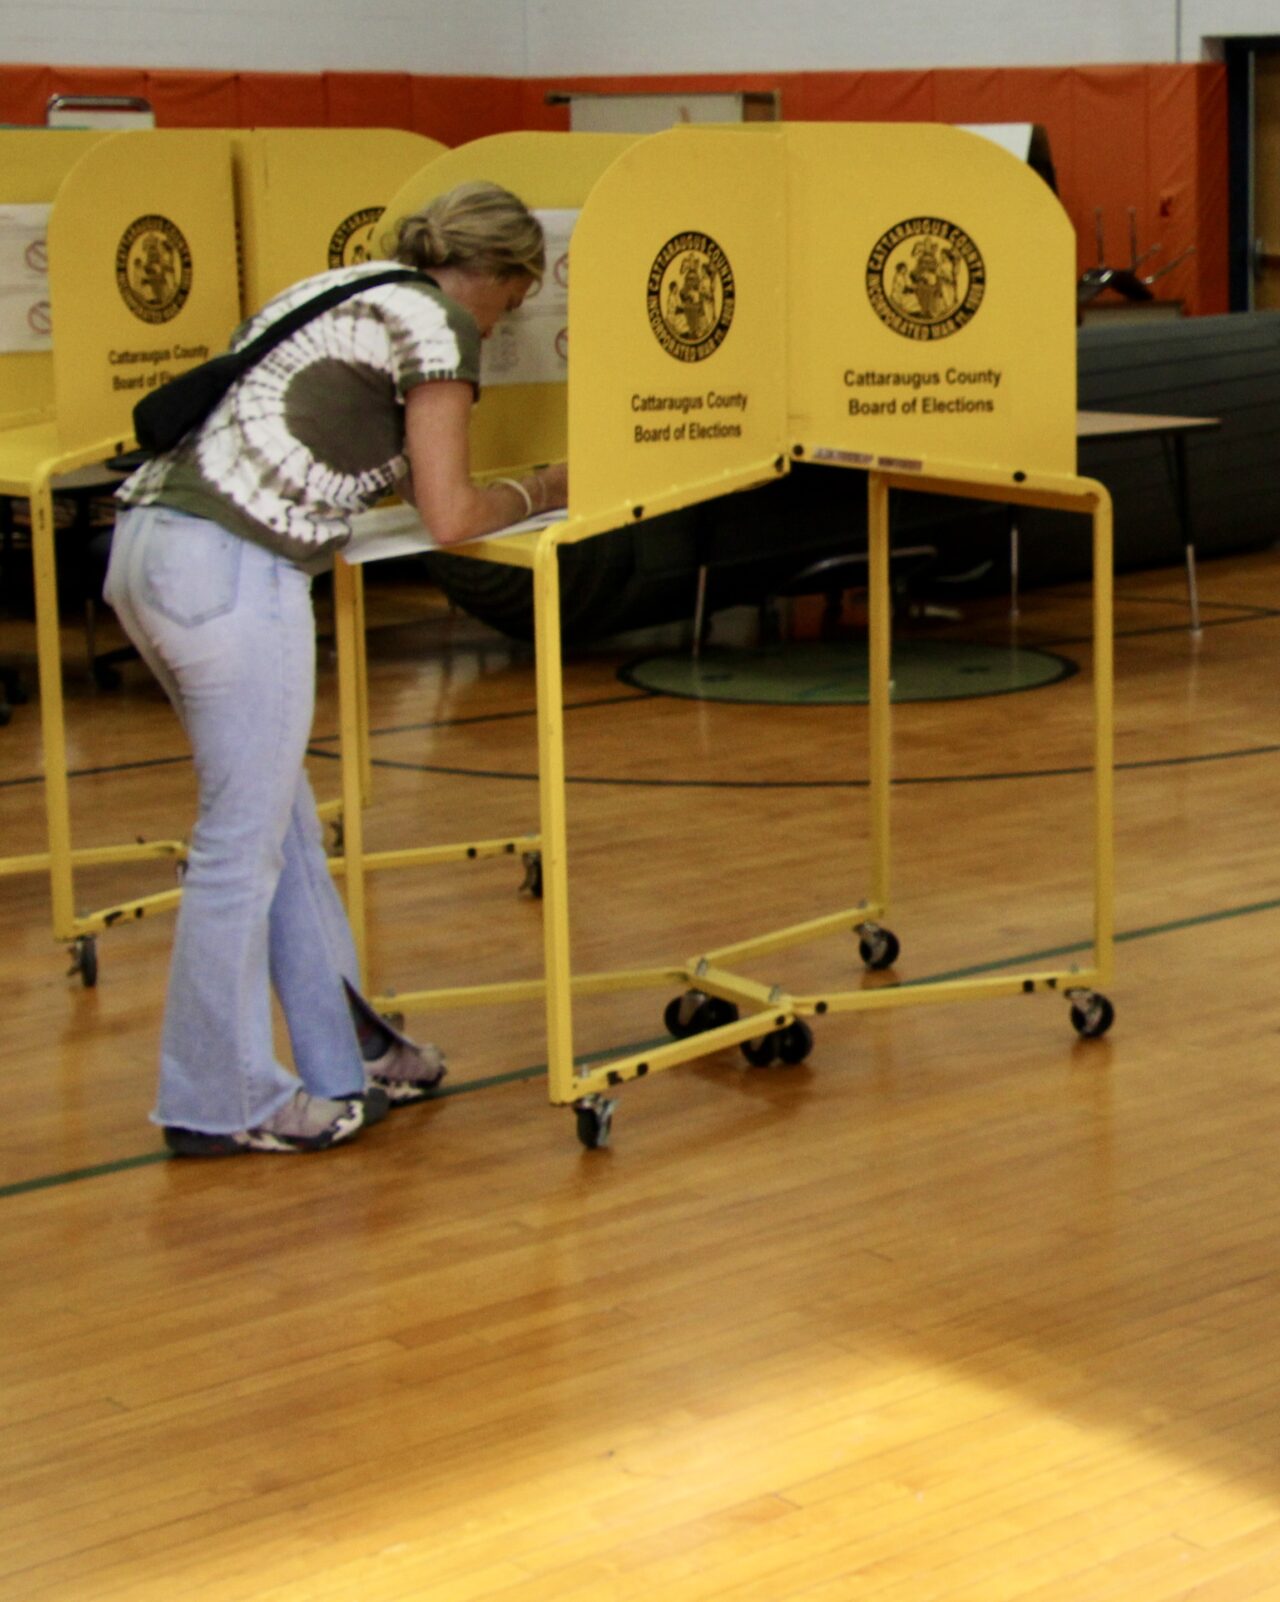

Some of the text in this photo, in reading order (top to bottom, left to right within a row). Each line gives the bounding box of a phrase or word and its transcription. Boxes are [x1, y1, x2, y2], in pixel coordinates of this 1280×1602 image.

[869, 219, 949, 270] CATTARAUGUS
[649, 233, 707, 288] CATTARAUGUS
[108, 345, 209, 366] Cattaraugus County
[112, 375, 144, 391] Board
[146, 373, 157, 387] of
[843, 367, 1002, 389] Cattaraugus County
[631, 391, 748, 414] Cattaraugus County
[848, 396, 994, 415] Board of Elections
[634, 421, 742, 443] Board of Elections
